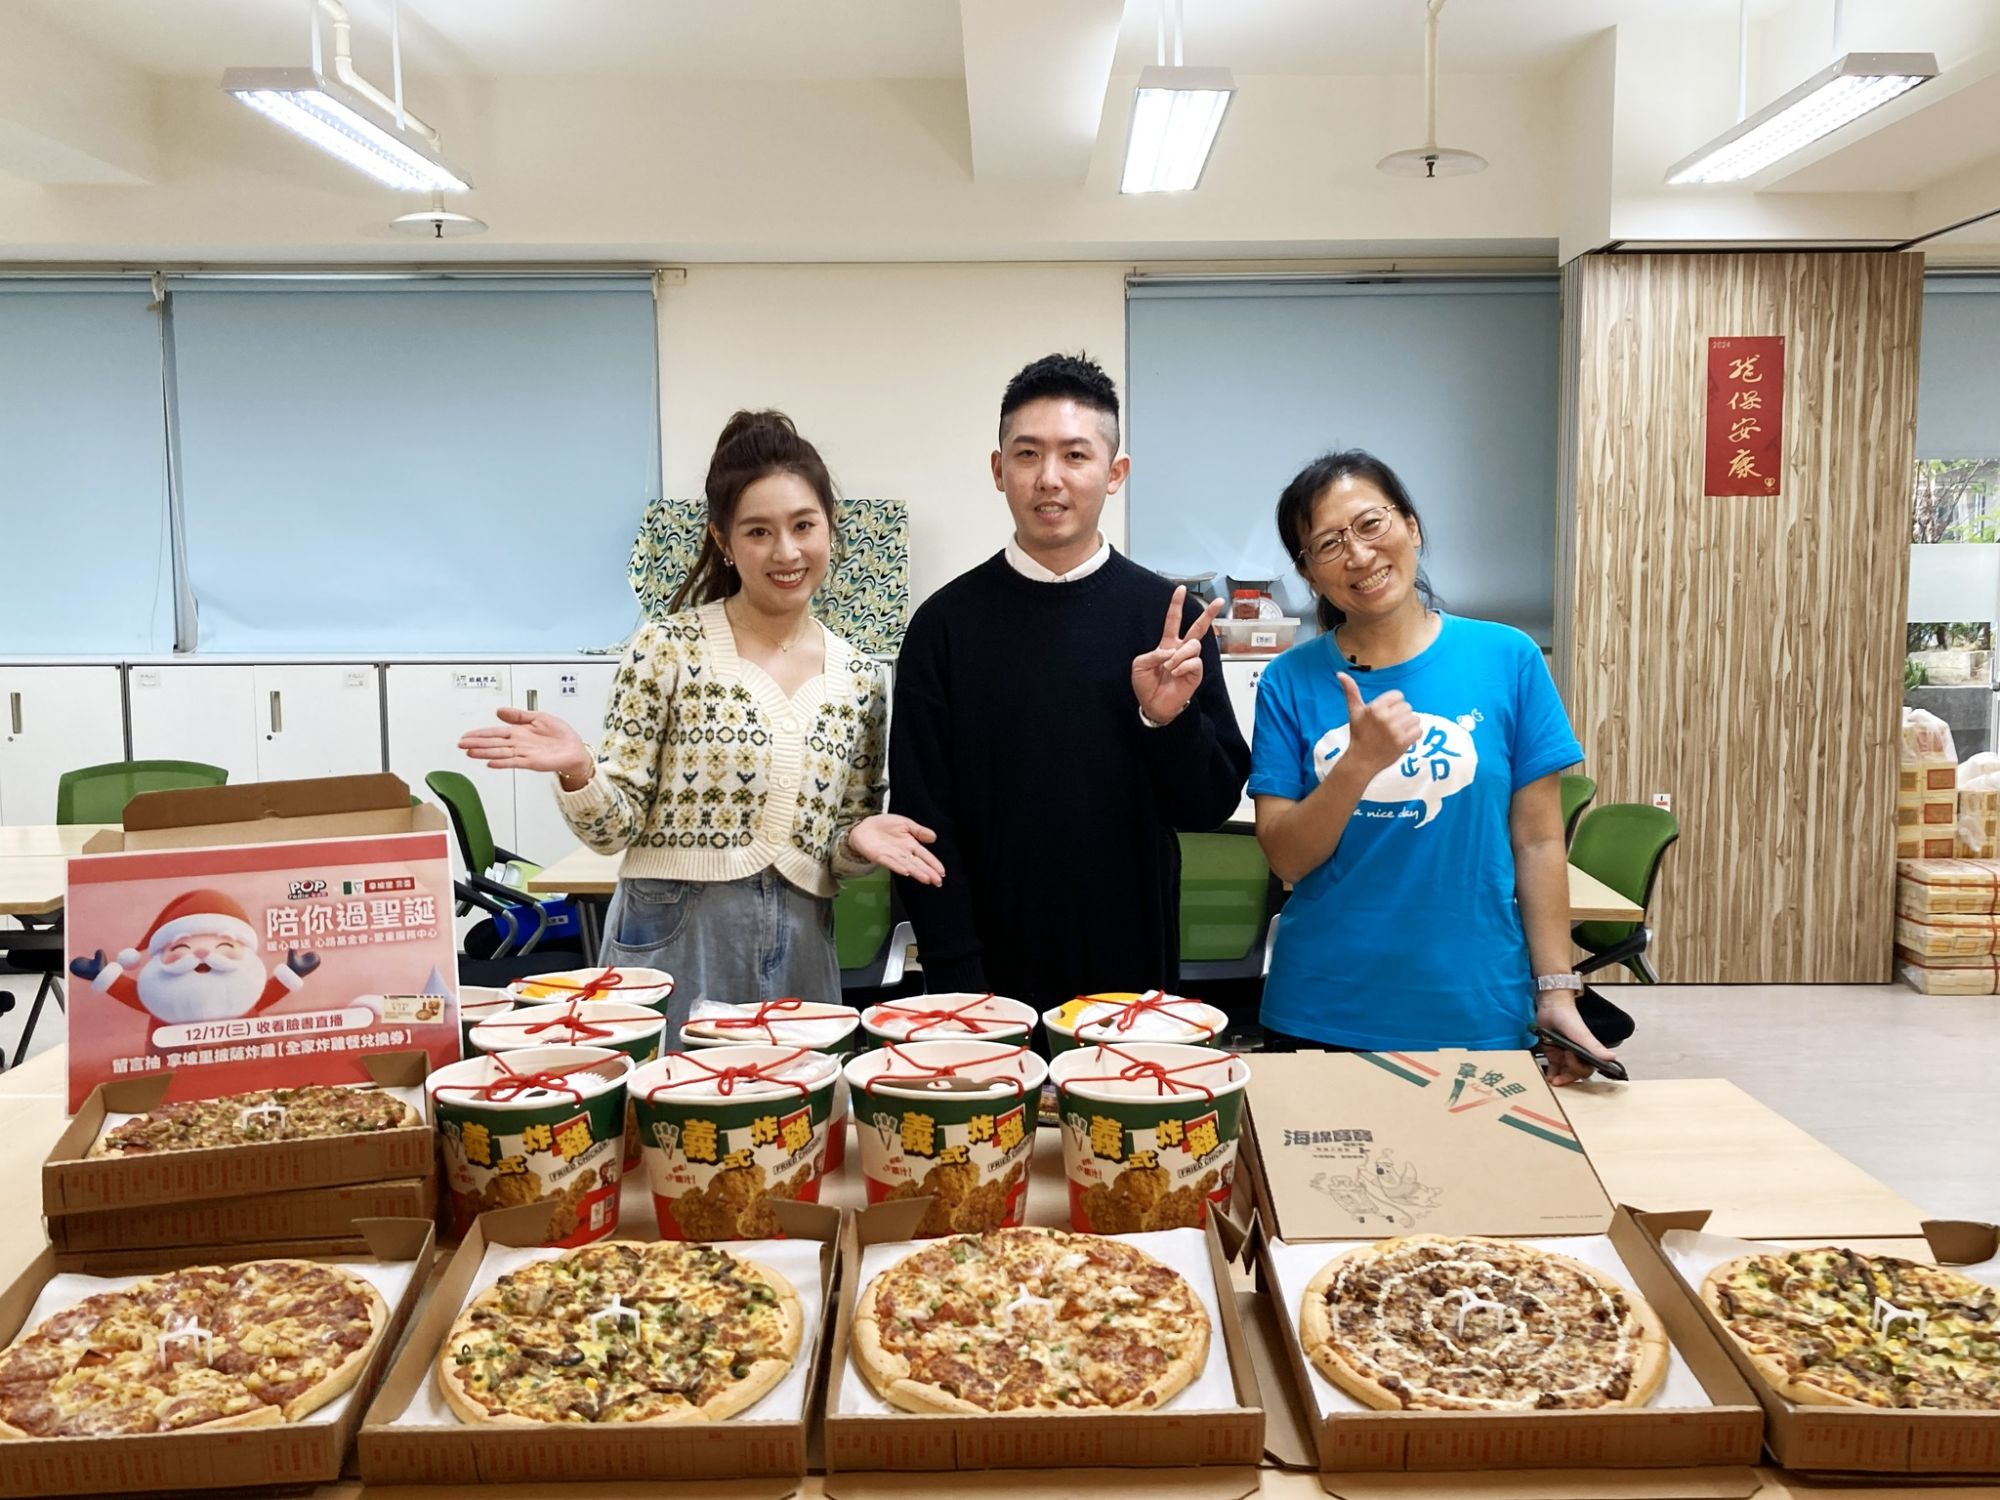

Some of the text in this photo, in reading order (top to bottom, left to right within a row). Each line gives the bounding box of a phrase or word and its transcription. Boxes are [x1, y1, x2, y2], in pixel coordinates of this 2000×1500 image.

[1367, 808, 1395, 818] nice
[1397, 806, 1419, 820] day
[289, 880, 327, 896] POP
[266, 896, 437, 938] 陪你過聖誕
[185, 1013, 344, 1041] 12/17(三) 收看臉書直播
[462, 1120, 594, 1174] 義式炸雞
[681, 1113, 814, 1168] 義式炸雞
[900, 1111, 1026, 1164] 義式炸雞
[1090, 1115, 1219, 1168] 義式炸雞
[1283, 1128, 1374, 1147] 海綿寶寶
[1181, 1161, 1204, 1178] FRIED
